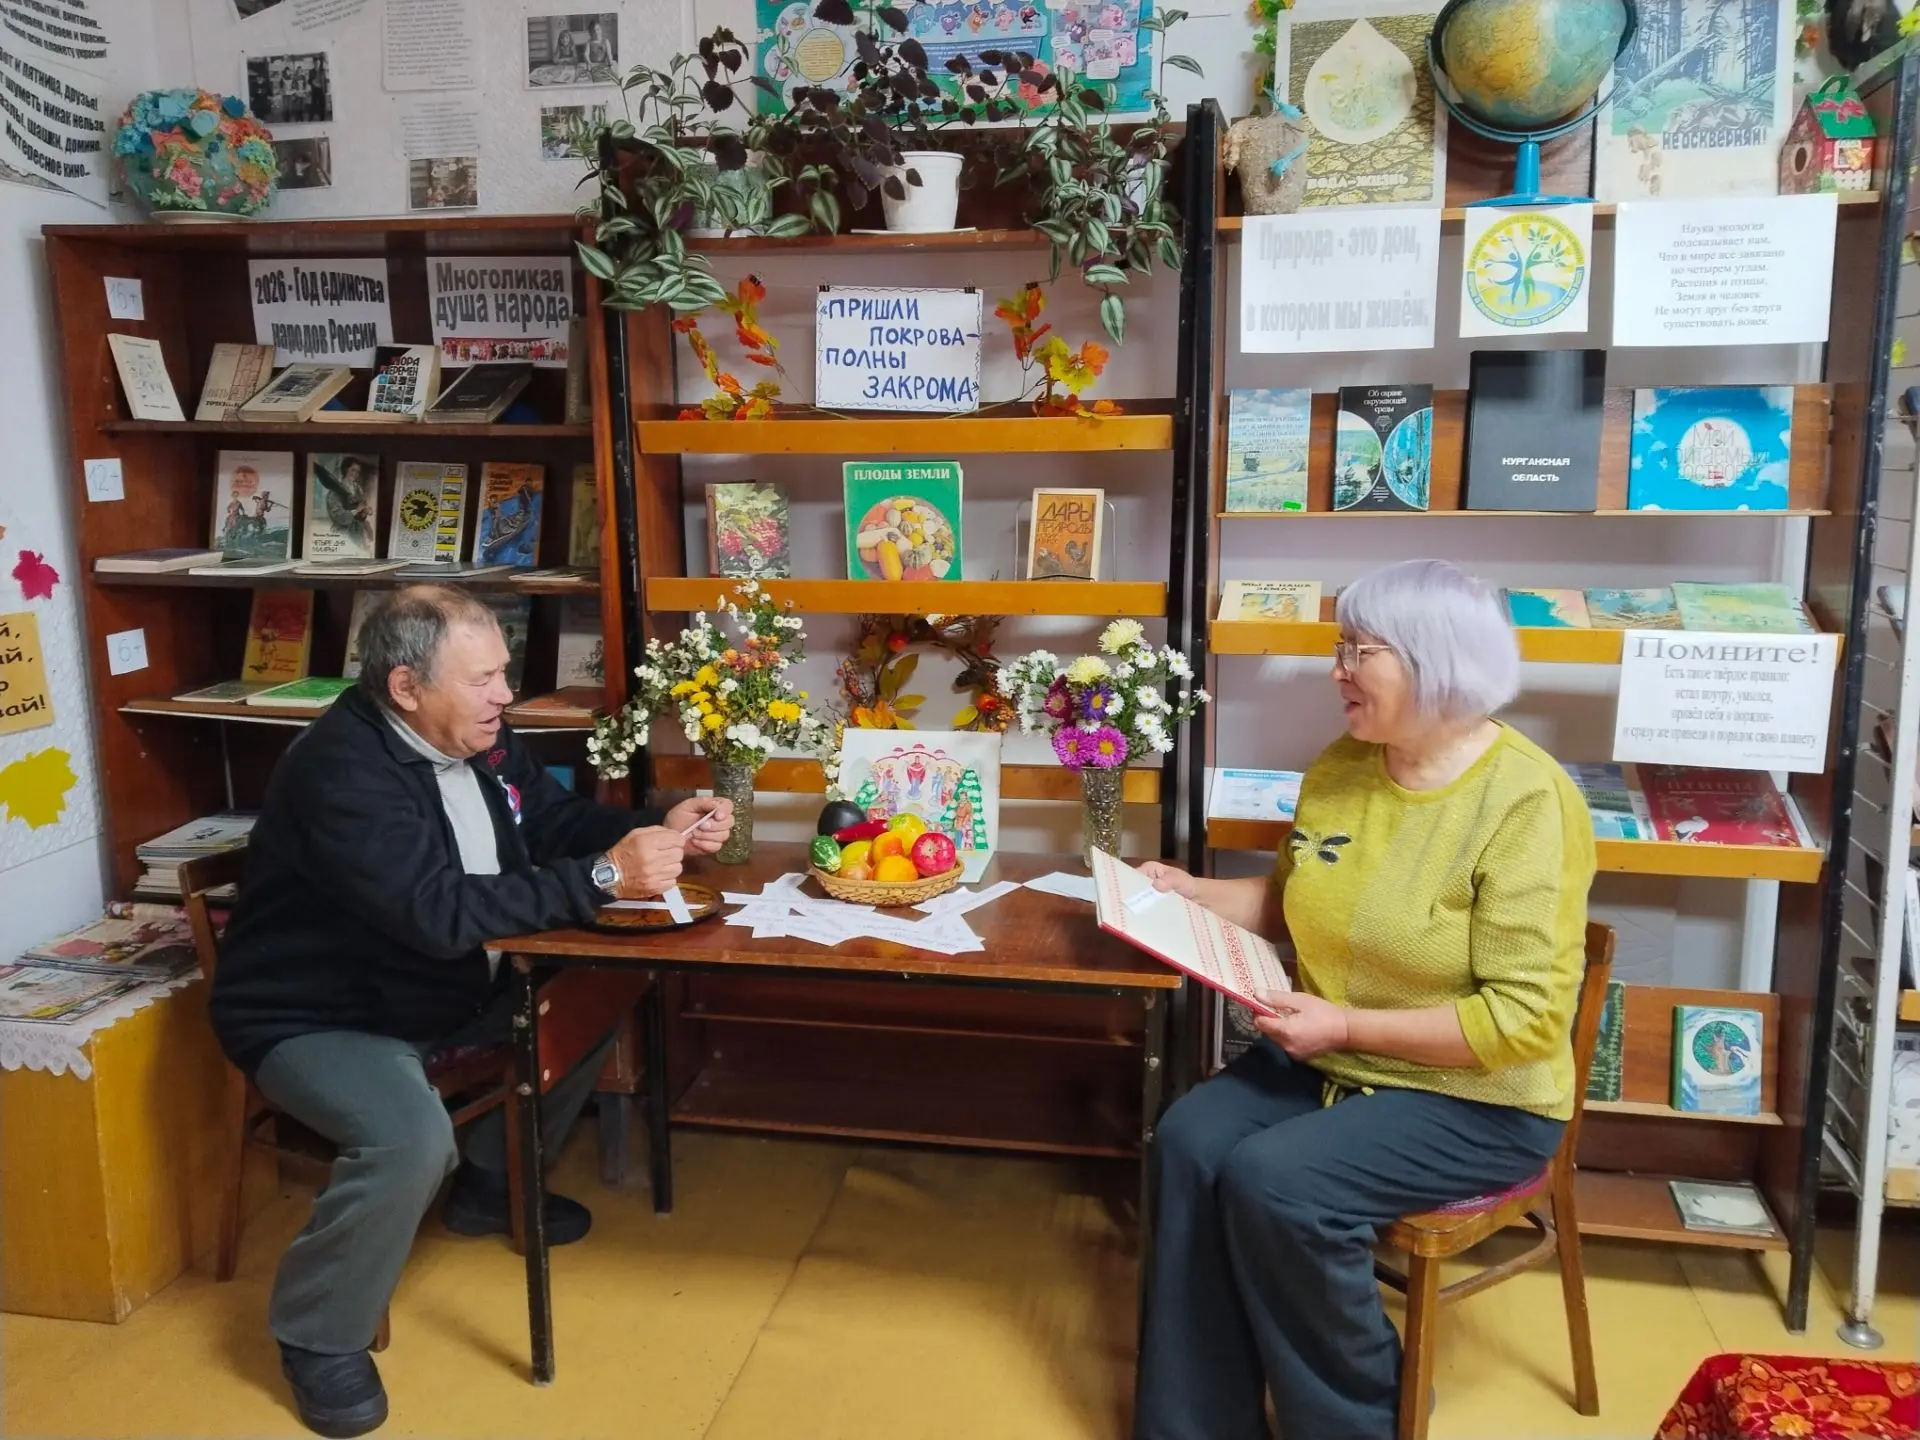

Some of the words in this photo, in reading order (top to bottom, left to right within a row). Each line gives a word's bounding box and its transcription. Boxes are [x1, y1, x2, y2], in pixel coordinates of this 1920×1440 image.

[14, 57, 21, 74] и
[22, 61, 63, 99] пятница,
[63, 84, 98, 112] друзья!
[5, 75, 41, 113] шуметь
[43, 100, 71, 126] никак
[0, 93, 26, 131] азлы,
[27, 117, 63, 151] шашки,
[6, 119, 62, 176] Интересное
[1681, 222, 1715, 236] Наука
[1717, 222, 1766, 233] экология
[1259, 221, 1334, 270] Природа
[1348, 225, 1378, 258] это
[1380, 224, 1422, 264] дом,
[1672, 237, 1745, 249] подсказывает
[1658, 251, 1679, 262] Что
[1690, 252, 1717, 263] мире
[1739, 249, 1786, 259] завязано
[436, 261, 564, 293] Многоликая
[1670, 266, 1685, 275] по
[255, 269, 287, 305] 2026
[293, 266, 321, 307] Год
[320, 270, 385, 307] единства
[1671, 277, 1719, 289] Растения
[1730, 276, 1769, 288] птицы,
[1675, 290, 1707, 302] Земля
[435, 293, 489, 331] душа
[493, 292, 570, 333] народа
[1245, 303, 1257, 333] в
[1260, 301, 1332, 342] котором
[1334, 300, 1363, 331] мы
[1365, 288, 1430, 330] живём.
[1655, 304, 1670, 316] Не
[1671, 305, 1703, 318] могут
[1704, 306, 1728, 317] друг
[1730, 302, 1750, 314] без
[1751, 303, 1783, 316] друга
[1662, 319, 1736, 331] существовать
[270, 321, 329, 359] народов
[328, 318, 378, 354] России
[825, 347, 906, 370] ПОЛНЫ
[1363, 396, 1408, 407] окружающей
[1368, 389, 1380, 397] Об
[1374, 406, 1395, 414] среды
[1692, 423, 1736, 448] Мой
[1502, 457, 1571, 466] КУРГАНСКАЯ
[854, 468, 902, 481] ПЛОДЫ
[905, 467, 951, 480] ЗЕМЛИ
[1511, 473, 1560, 482] ОБЛАСТЬ
[1038, 501, 1095, 522] ДАРЫ
[1634, 635, 1820, 665] Помните!
[1663, 664, 1685, 680] Есть
[1630, 727, 1654, 744] сразу
[1656, 728, 1670, 739] же
[1717, 731, 1754, 746] порядок
[1755, 733, 1779, 744] свою
